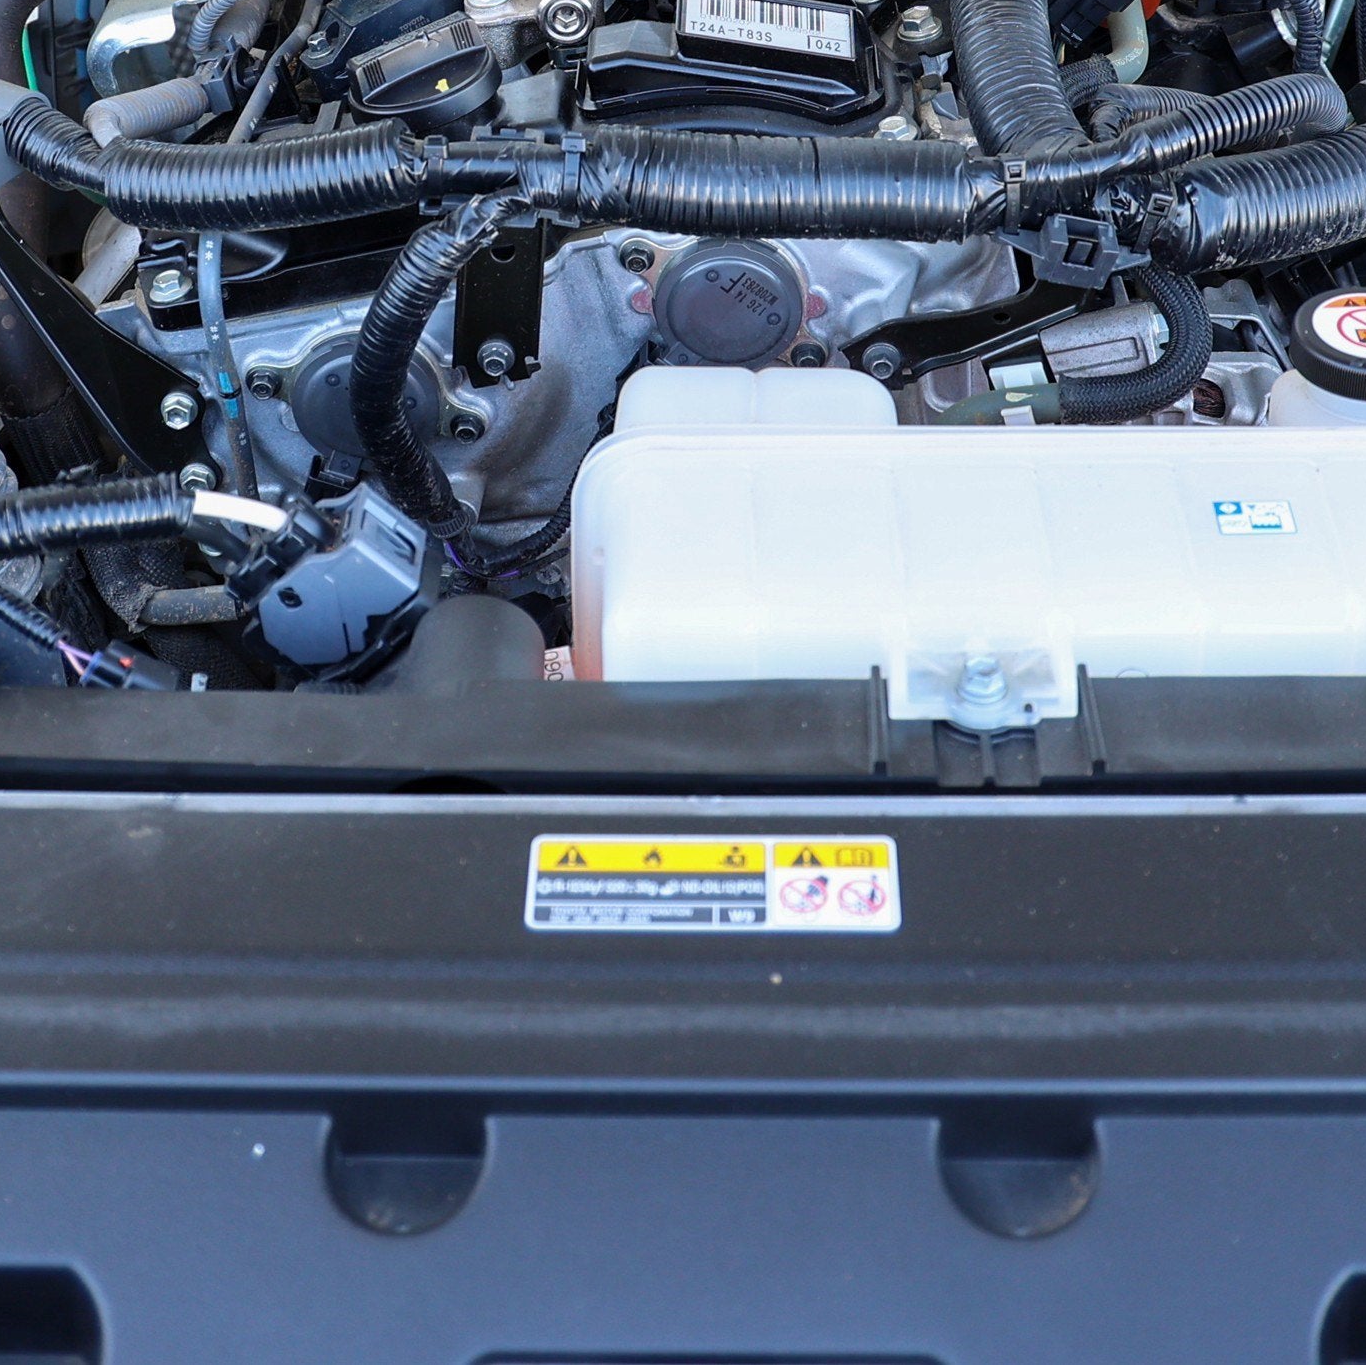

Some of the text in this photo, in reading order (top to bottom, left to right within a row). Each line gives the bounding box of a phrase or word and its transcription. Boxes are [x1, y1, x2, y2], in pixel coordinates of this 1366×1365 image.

[398, 15, 425, 32] TOYOTA
[690, 20, 773, 43] T24A-T83S
[815, 39, 842, 53] 042
[720, 272, 746, 293] F
